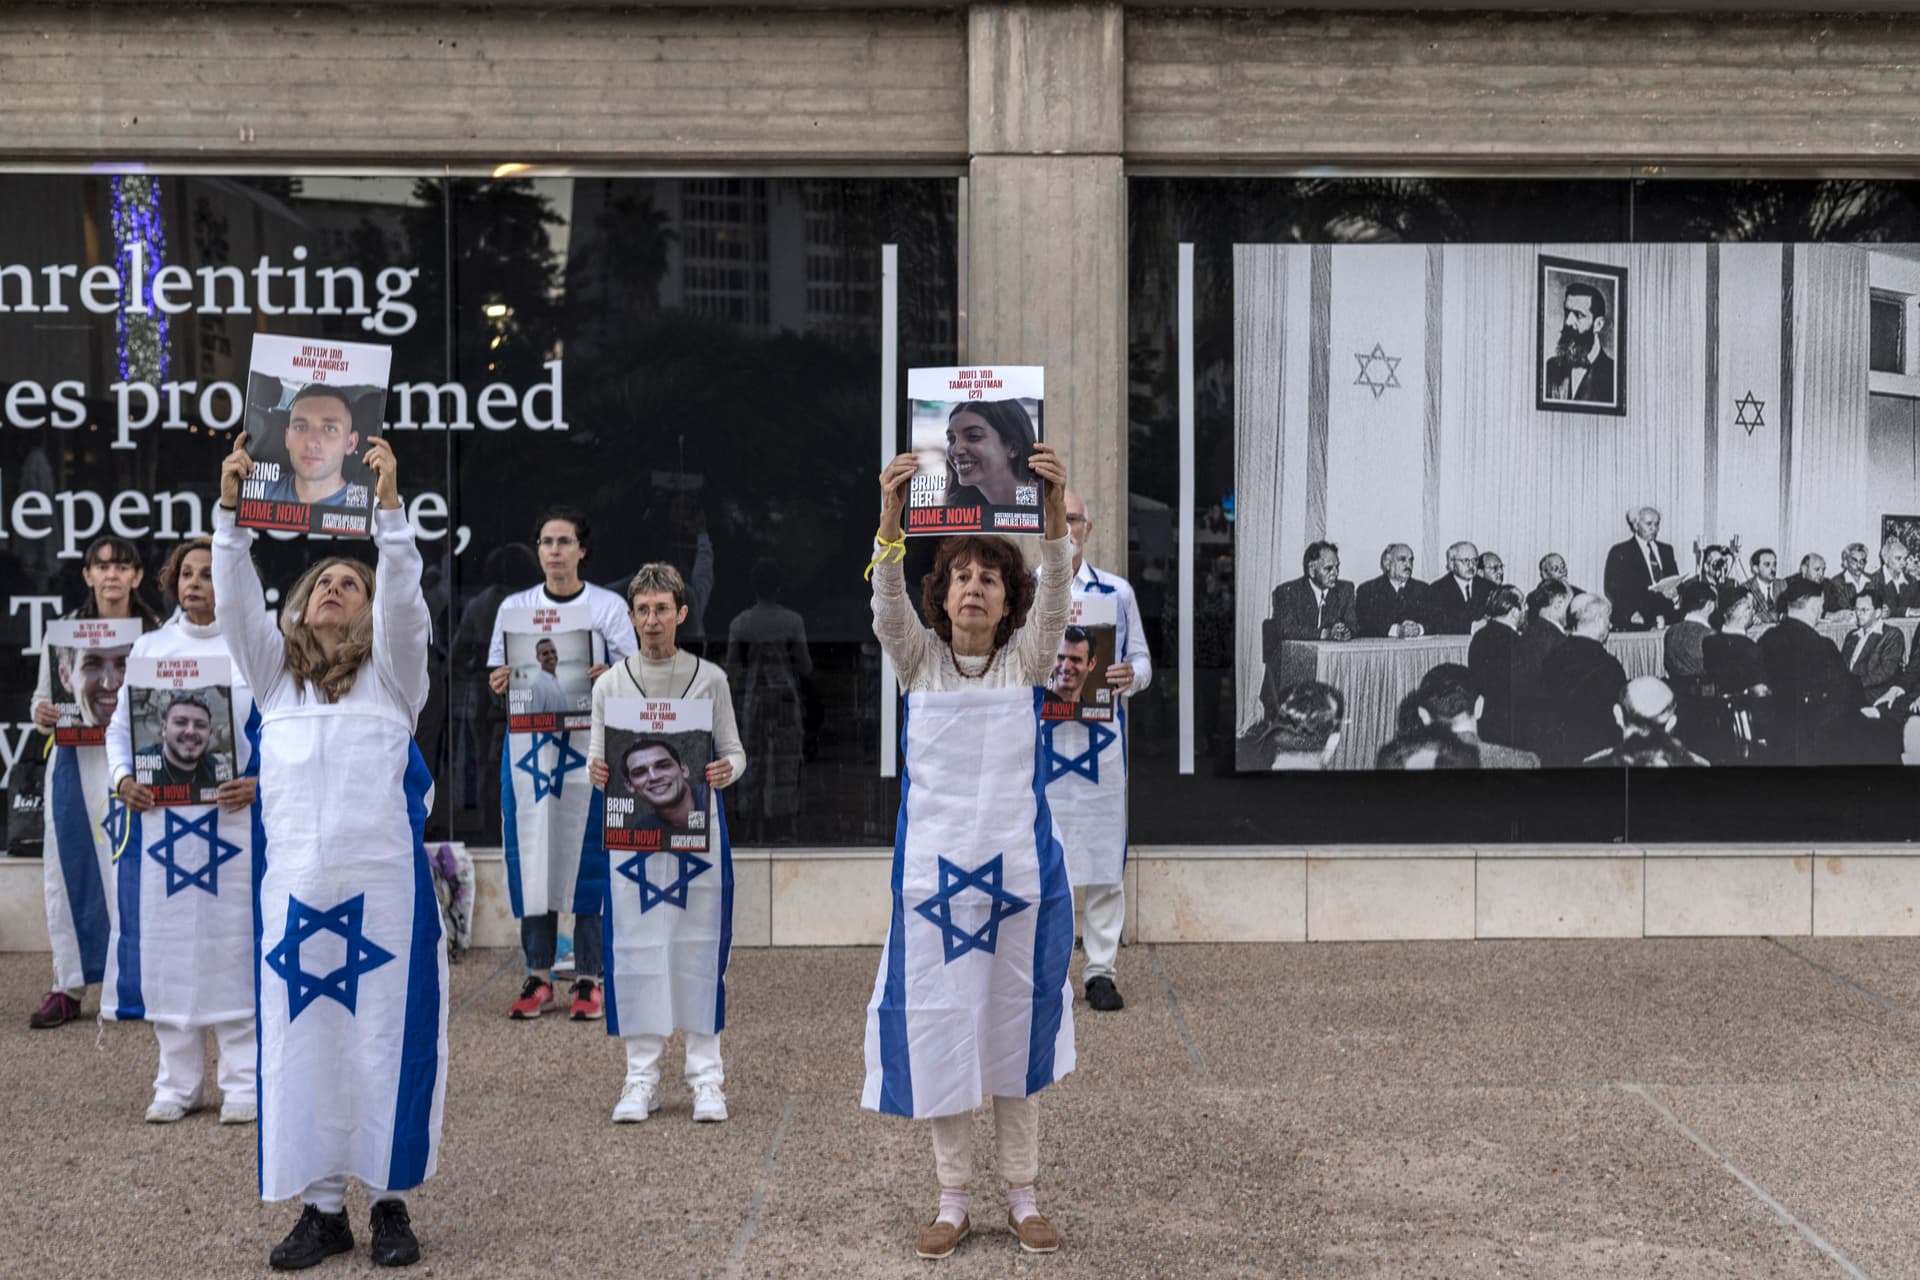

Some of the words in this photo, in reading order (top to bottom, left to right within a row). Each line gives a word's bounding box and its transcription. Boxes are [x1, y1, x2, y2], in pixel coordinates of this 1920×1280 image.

[292, 356, 316, 368] MATAN
[318, 360, 350, 372] ANGREST
[312, 370, 326, 381] (21)
[949, 380, 973, 390] TAMAR
[974, 379, 1003, 389] GUTMAN
[968, 390, 983, 400] (27)
[110, 359, 569, 449] promed
[242, 480, 266, 500] HIM
[910, 474, 947, 492] BRING
[910, 491, 934, 508] HER
[240, 500, 273, 521] HOME
[276, 503, 311, 524] NOW!
[909, 508, 943, 526] HOME
[946, 505, 982, 524] NOW!
[135, 755, 162, 771] BRING
[136, 770, 153, 785] HIM
[163, 784, 191, 800] NOW!
[606, 797, 635, 813] BRING
[606, 812, 624, 828] HIM
[606, 829, 632, 844] HOME
[633, 828, 662, 845] NOW!
